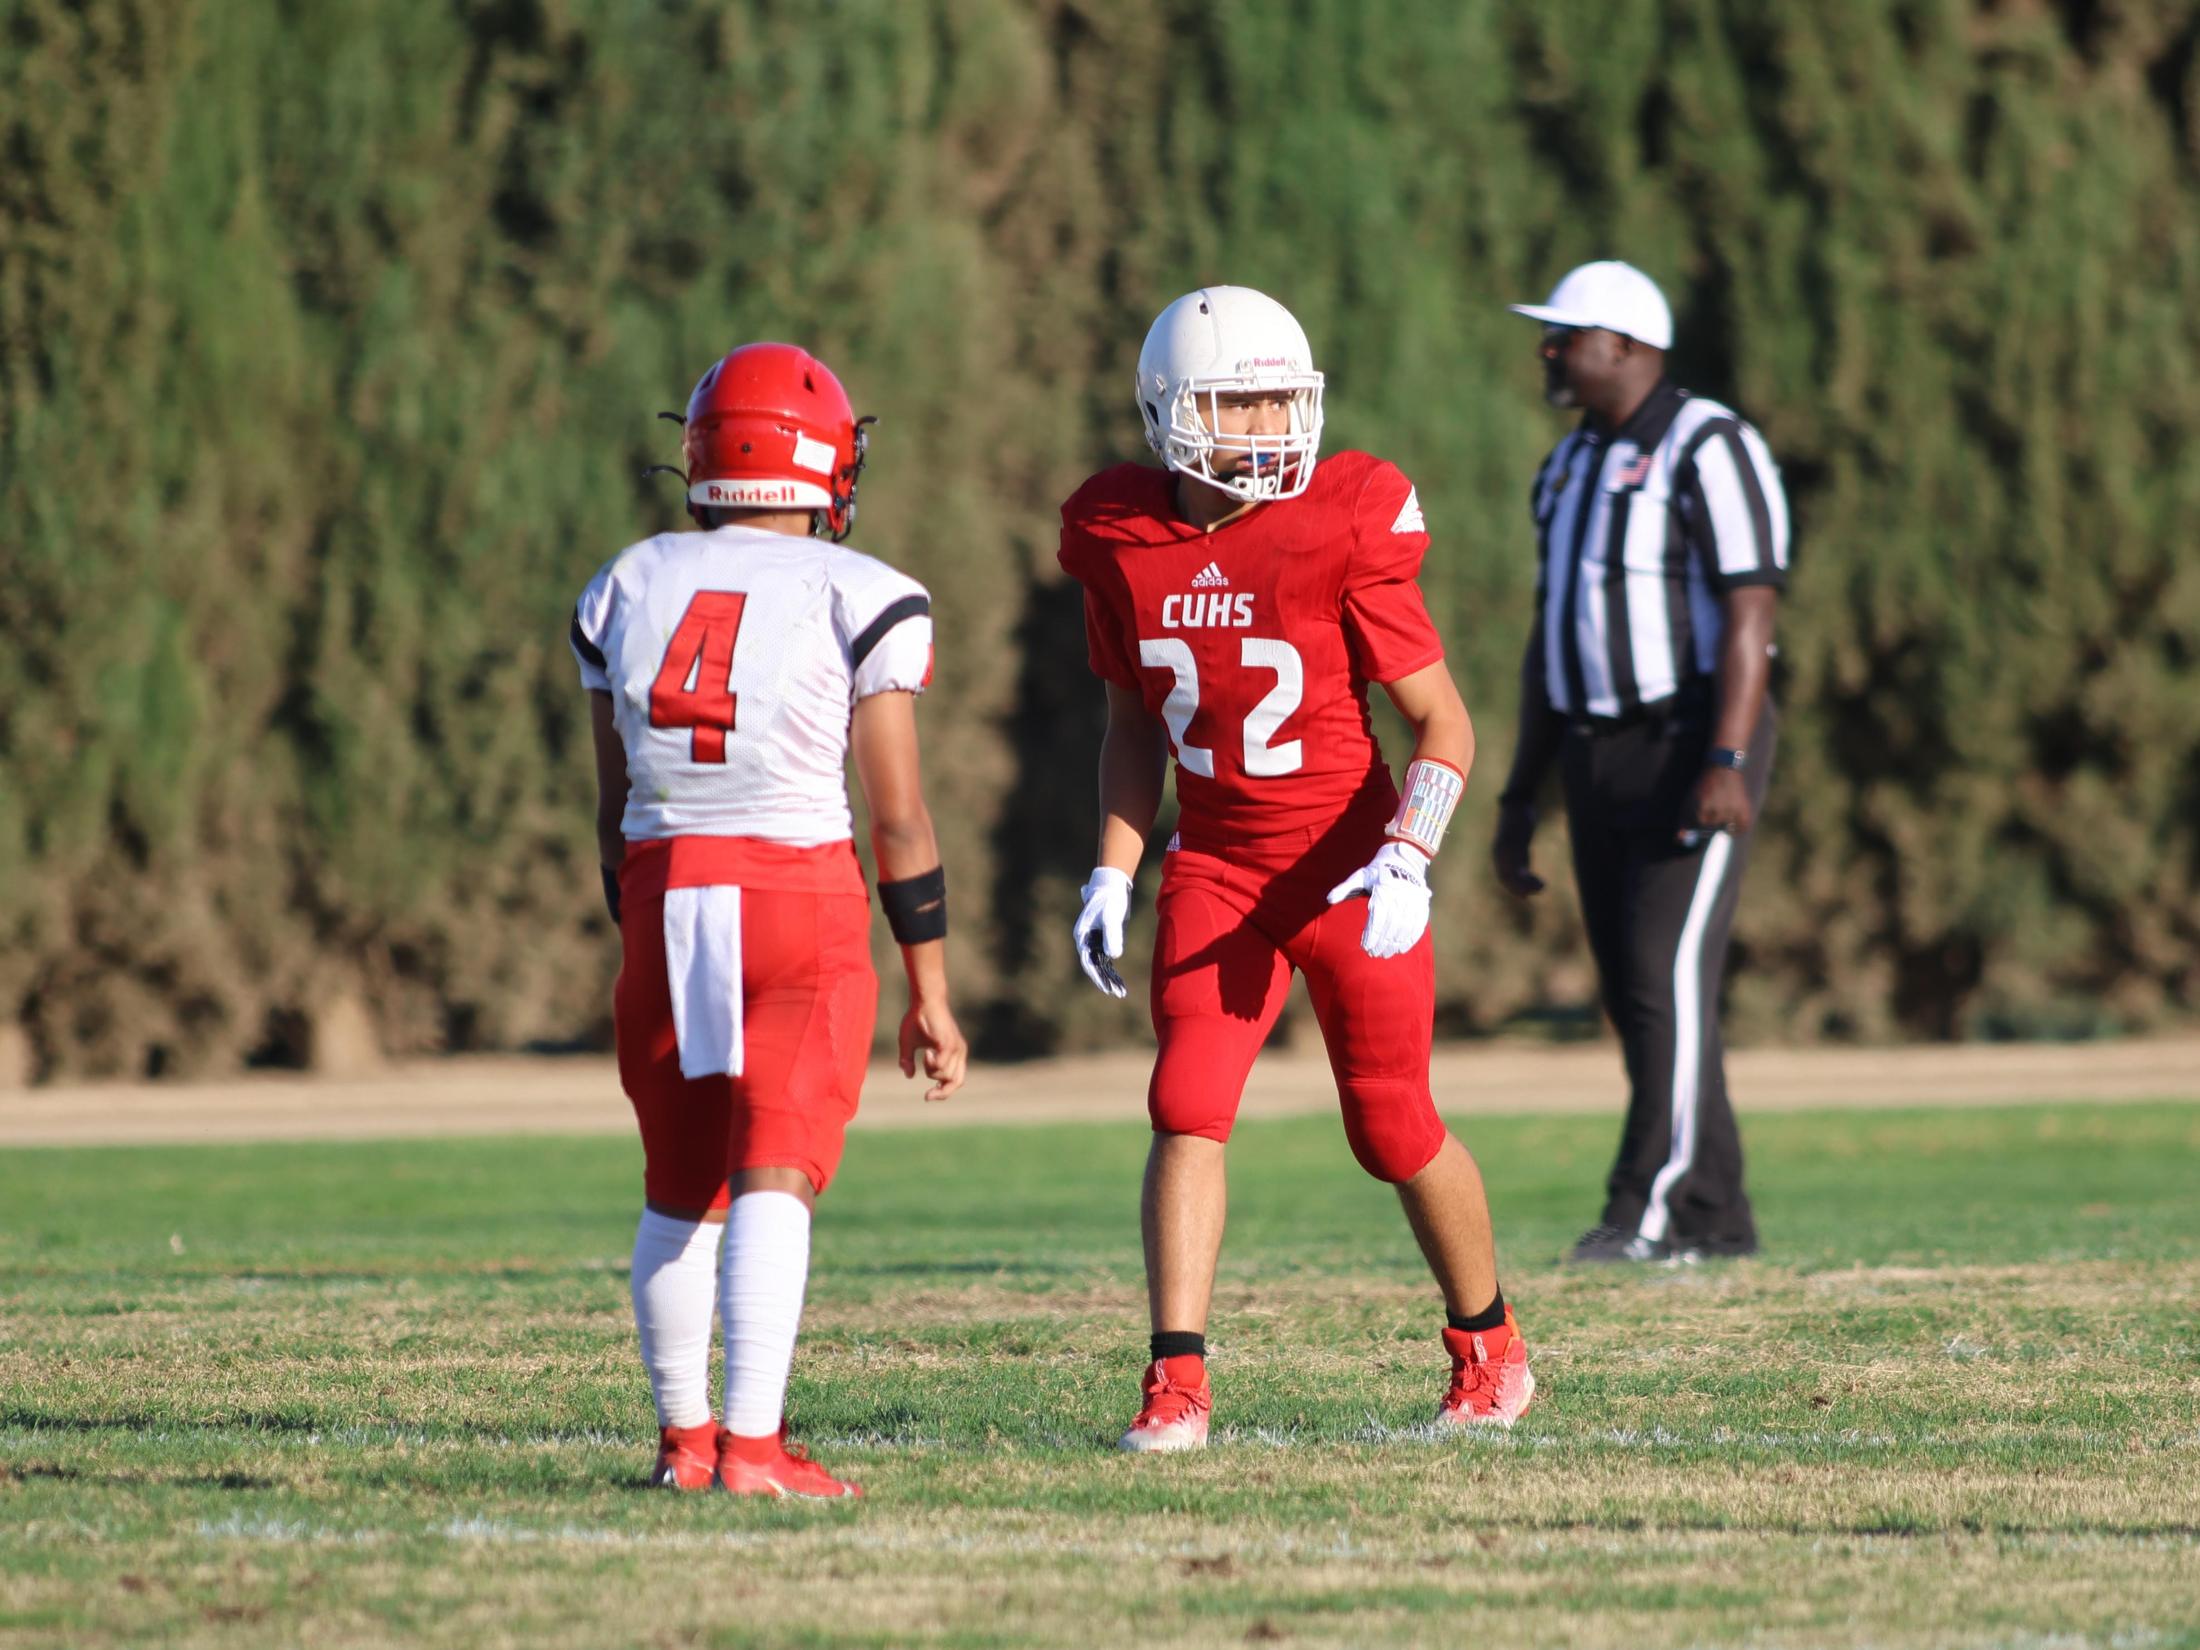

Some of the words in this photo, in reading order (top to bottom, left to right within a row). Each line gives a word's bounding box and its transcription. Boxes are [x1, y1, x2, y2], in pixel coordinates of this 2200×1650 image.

[1253, 356, 1286, 367] Riddell
[708, 485, 795, 502] Riddell
[1191, 576, 1229, 588] adidas
[1162, 593, 1255, 628] CUHS
[649, 590, 748, 764] 4
[1139, 637, 1304, 779] 22
